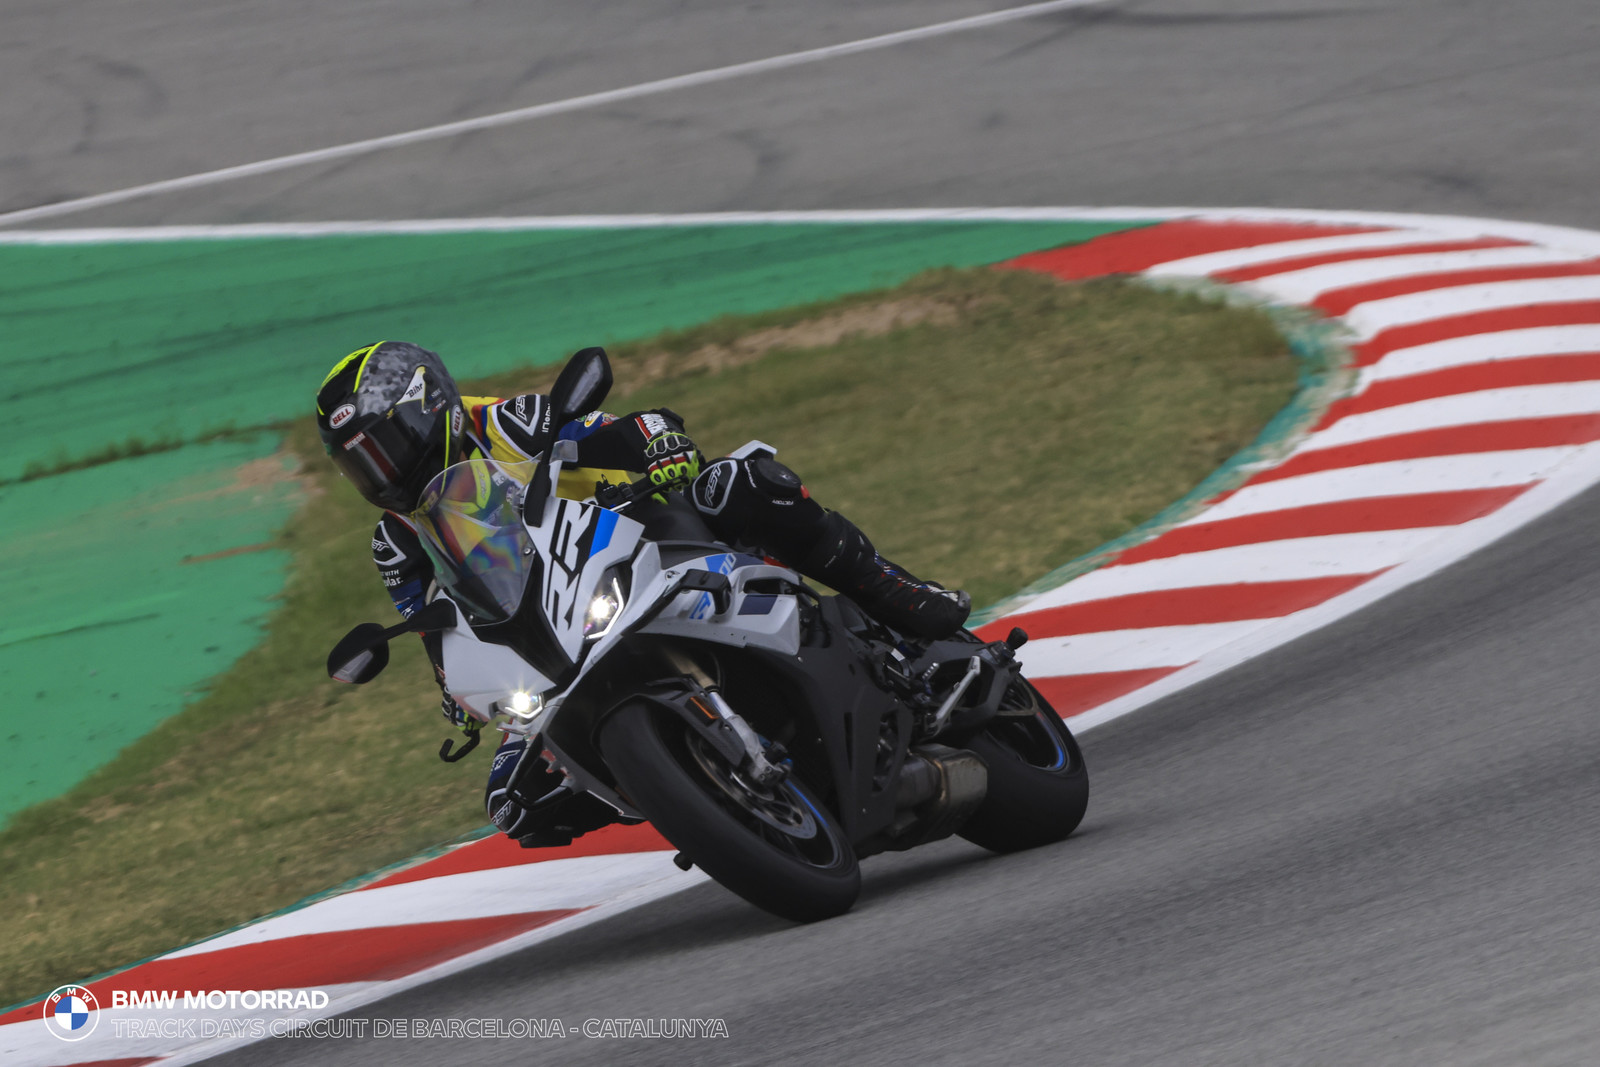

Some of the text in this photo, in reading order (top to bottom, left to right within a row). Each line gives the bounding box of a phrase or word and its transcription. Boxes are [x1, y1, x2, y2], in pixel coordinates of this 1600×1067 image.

[406, 382, 424, 398] Bihr
[332, 408, 352, 425] BELL
[515, 394, 528, 422] RS
[453, 410, 462, 432] BELL
[704, 462, 722, 507] RST
